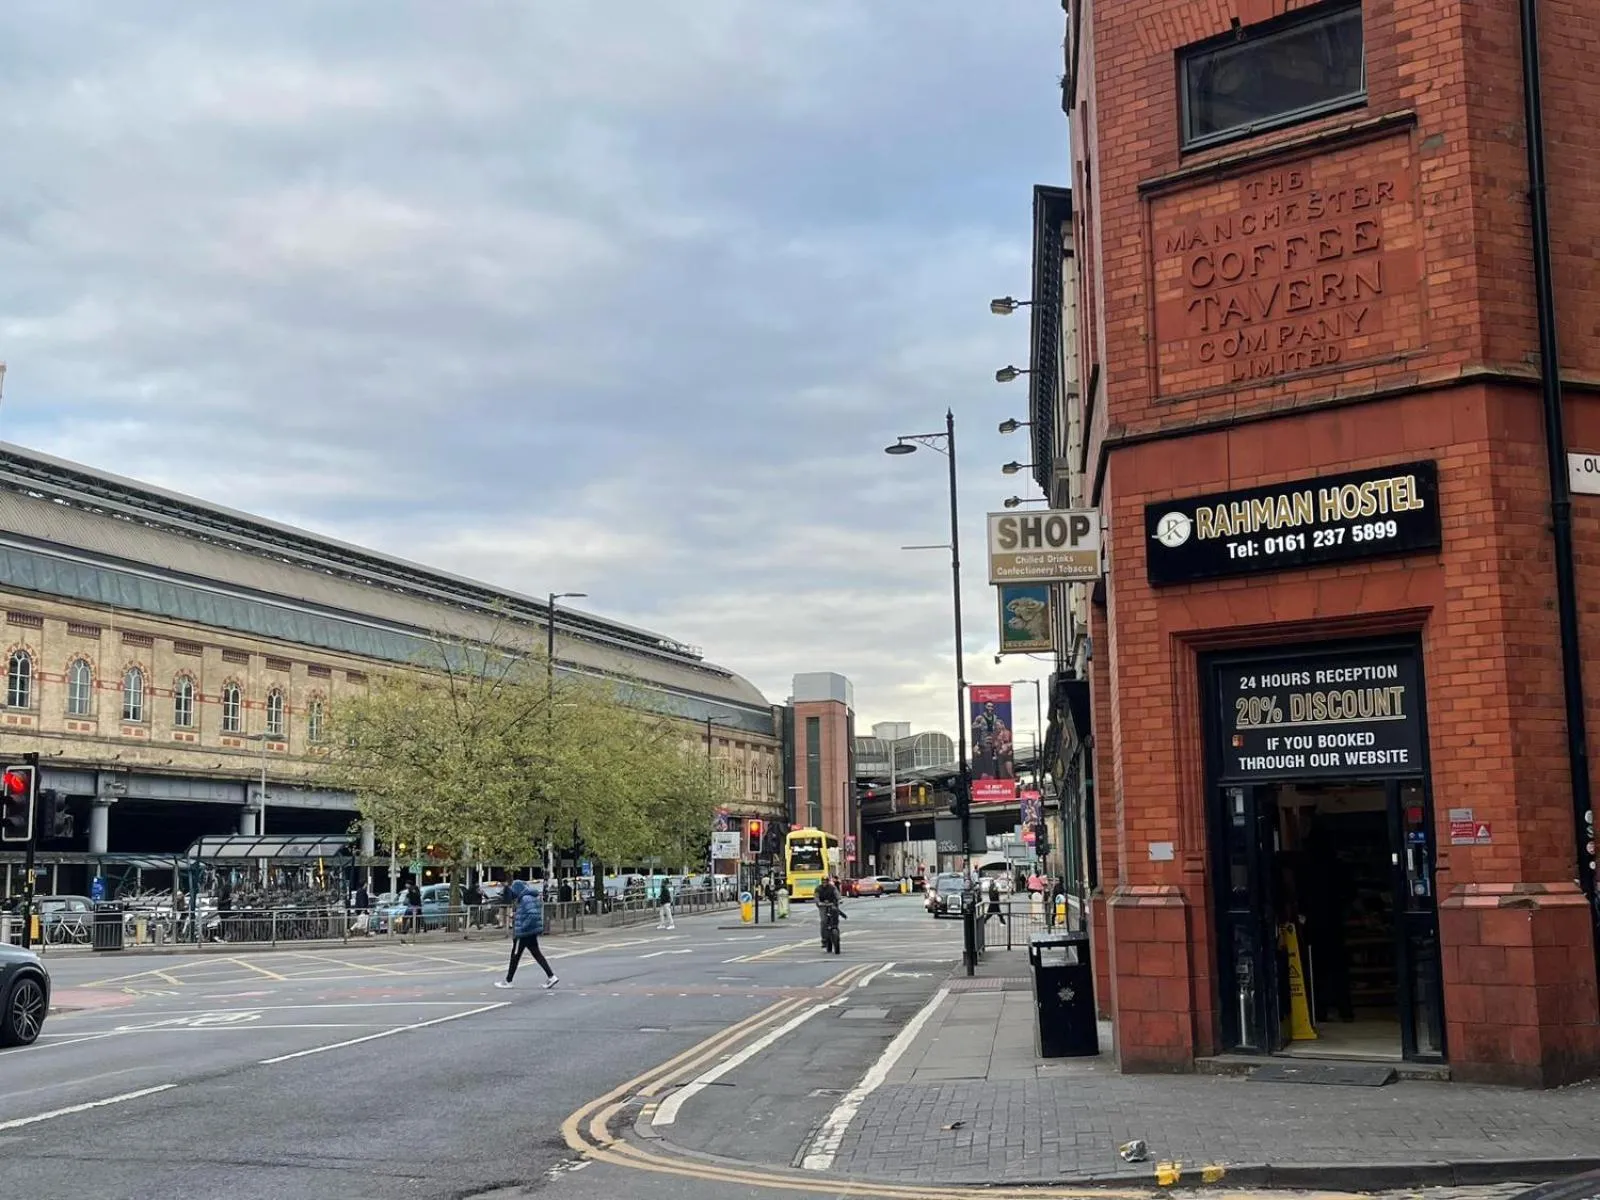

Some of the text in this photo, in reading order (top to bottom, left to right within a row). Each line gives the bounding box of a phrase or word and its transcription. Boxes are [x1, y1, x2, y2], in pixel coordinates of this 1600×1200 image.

[1246, 172, 1304, 200] THE
[1166, 181, 1394, 253] MANCHESTER
[1189, 220, 1380, 288] COFFEE
[1188, 259, 1383, 331] TAVERN
[1199, 307, 1369, 363] COMPANY
[1231, 345, 1341, 381] LIMITED
[1196, 475, 1424, 540] RAHMAN HOSTEL
[998, 515, 1090, 549] SHOP
[1227, 520, 1397, 560] Tel: 0161 237 5899
[1240, 664, 1398, 690] 24 HOURS RECEPTION
[1235, 686, 1405, 725] 20% DISCOUNT
[1238, 750, 1409, 770] THROUGH OUR WEBSITE
[1267, 732, 1375, 750] IF YOU BOOKED
